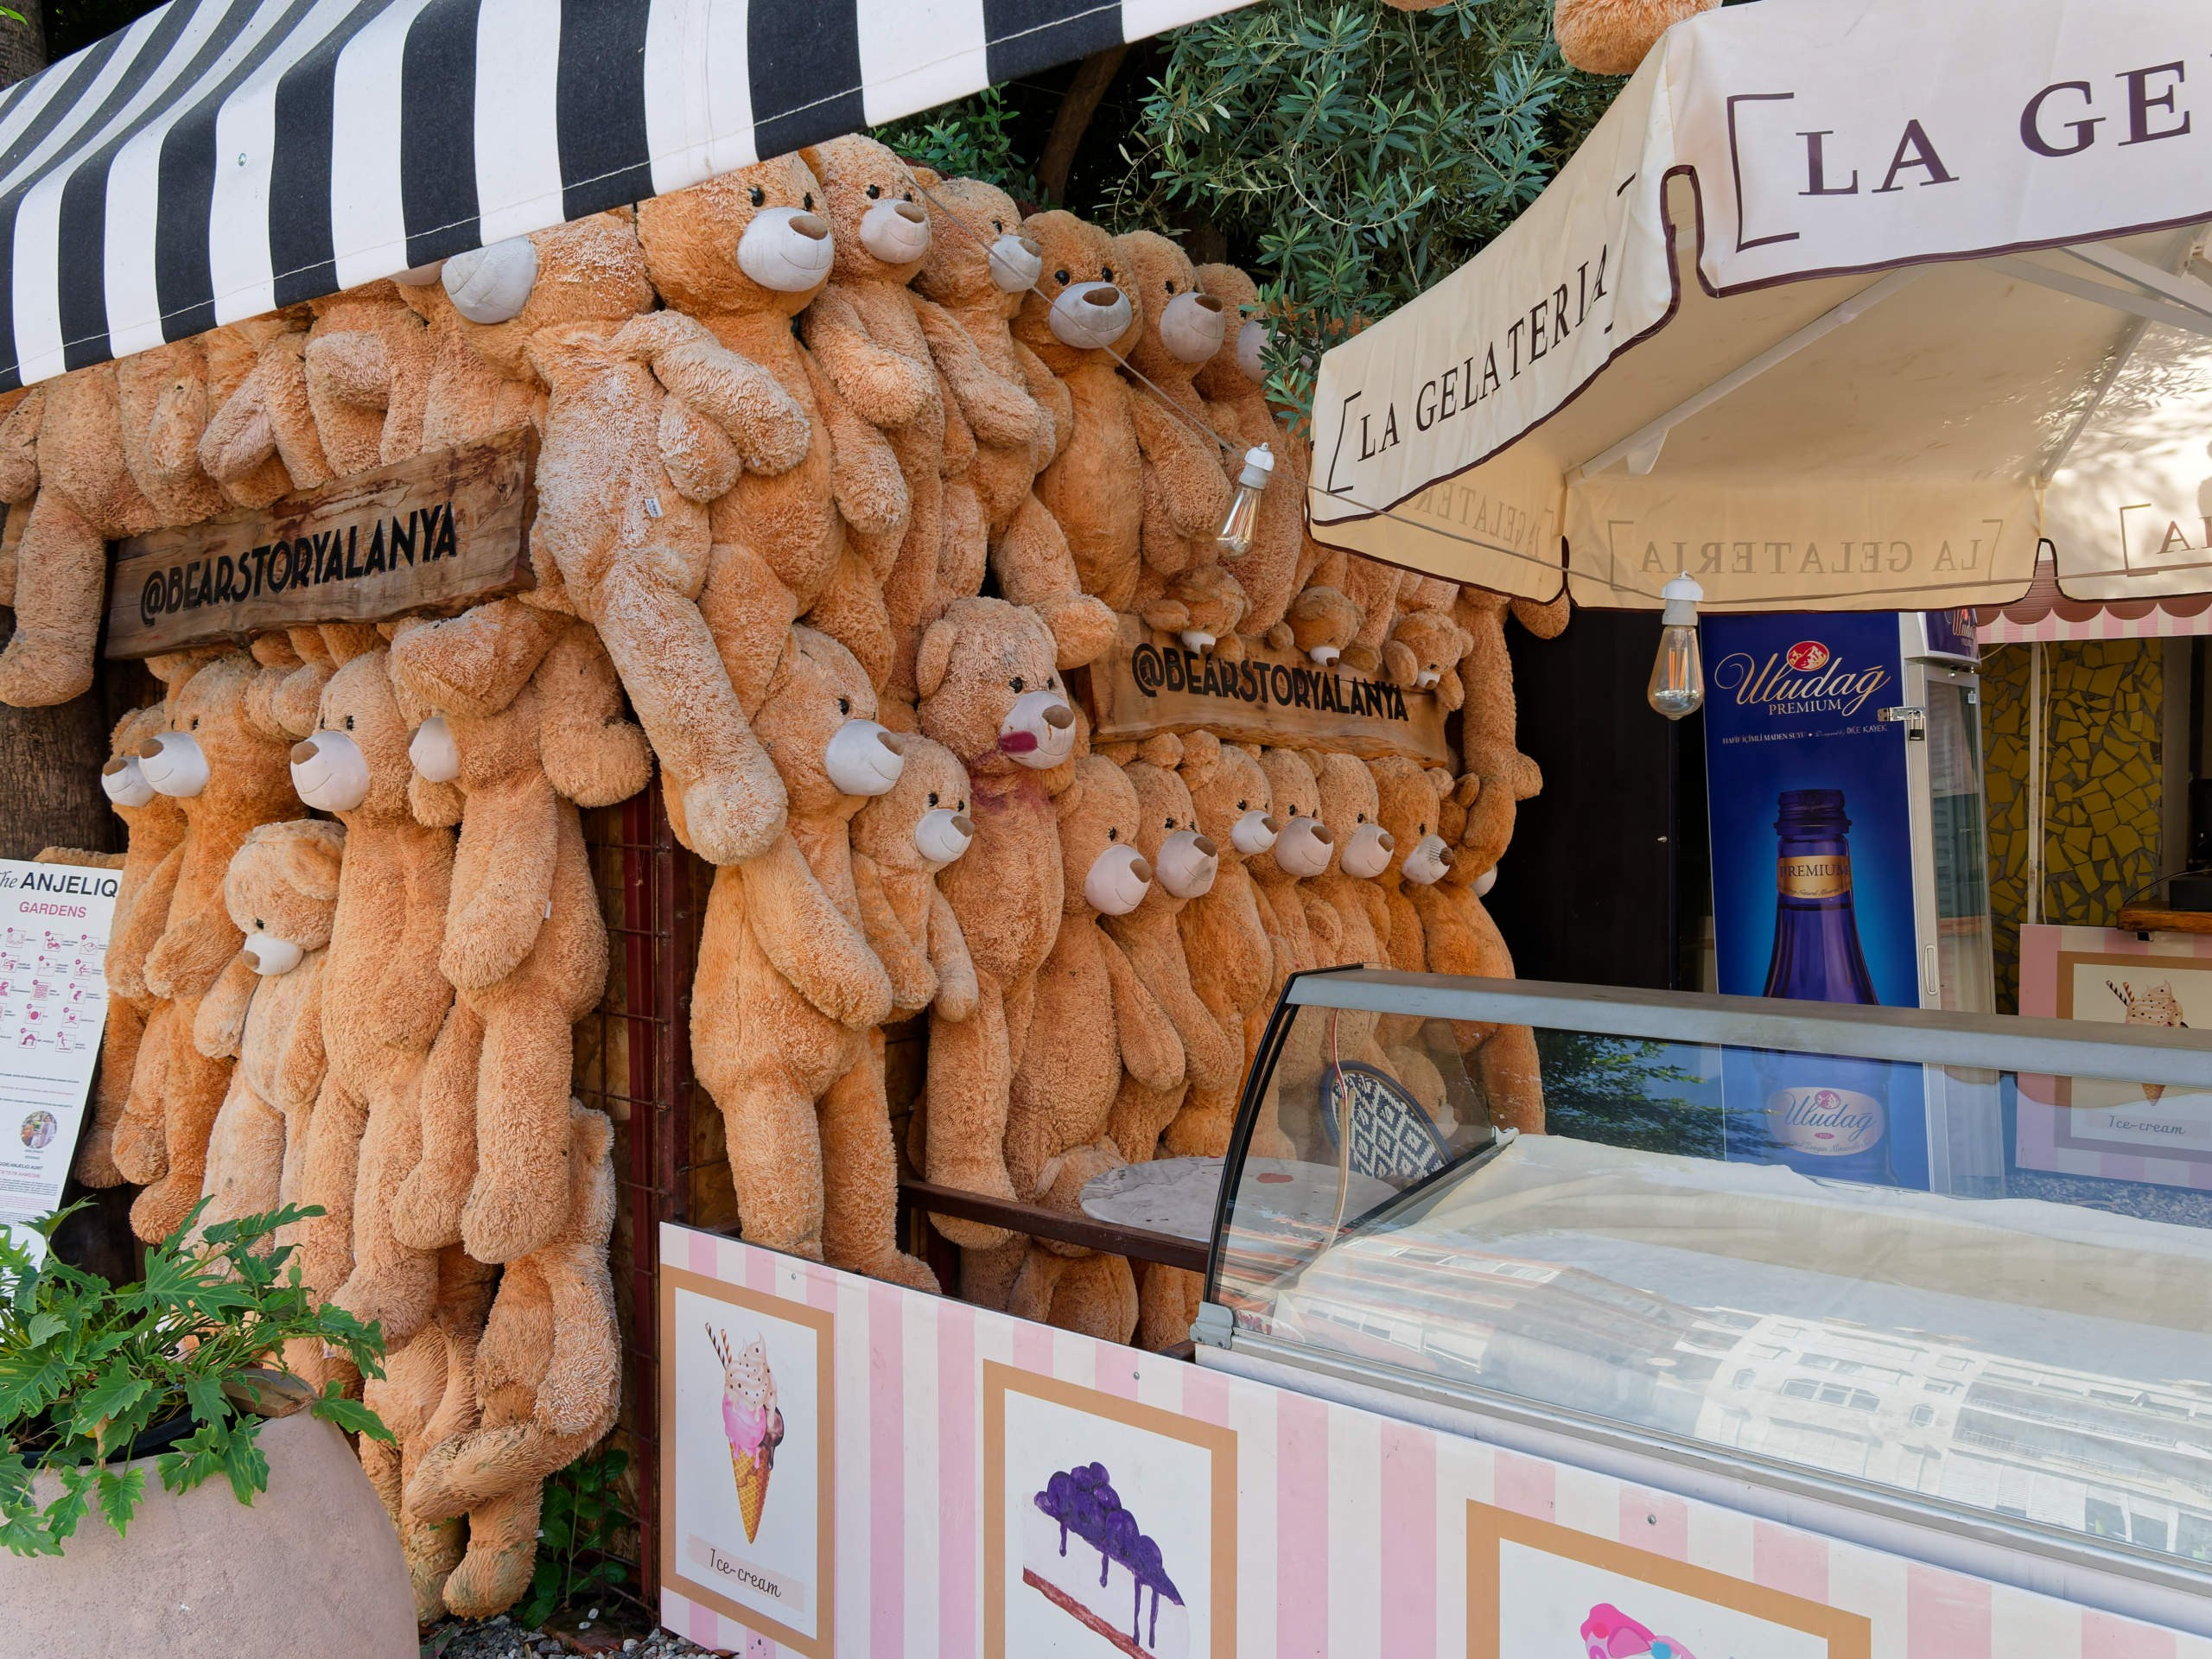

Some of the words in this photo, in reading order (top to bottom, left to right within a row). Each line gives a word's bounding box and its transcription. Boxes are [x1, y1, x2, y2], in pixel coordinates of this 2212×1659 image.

[1796, 118, 1960, 195] LA
[2020, 54, 2212, 157] GE
[1357, 402, 1400, 461] LA
[1415, 243, 1607, 431] GELATERIA
[140, 500, 458, 627] @BEARSTORYALANYA
[1131, 642, 1409, 722] @BEARSTORYALANYA
[1714, 652, 1891, 716] Uludağ
[1769, 698, 1842, 716] PREMIUM
[20, 871, 118, 898] ANJELIQ
[1780, 863, 1850, 877] PREMIUM
[19, 900, 87, 918] GARDENS
[1771, 1090, 1877, 1142] Uludağ
[2109, 1114, 2186, 1135] Ice-cream
[710, 1548, 782, 1599] Ice-cream
